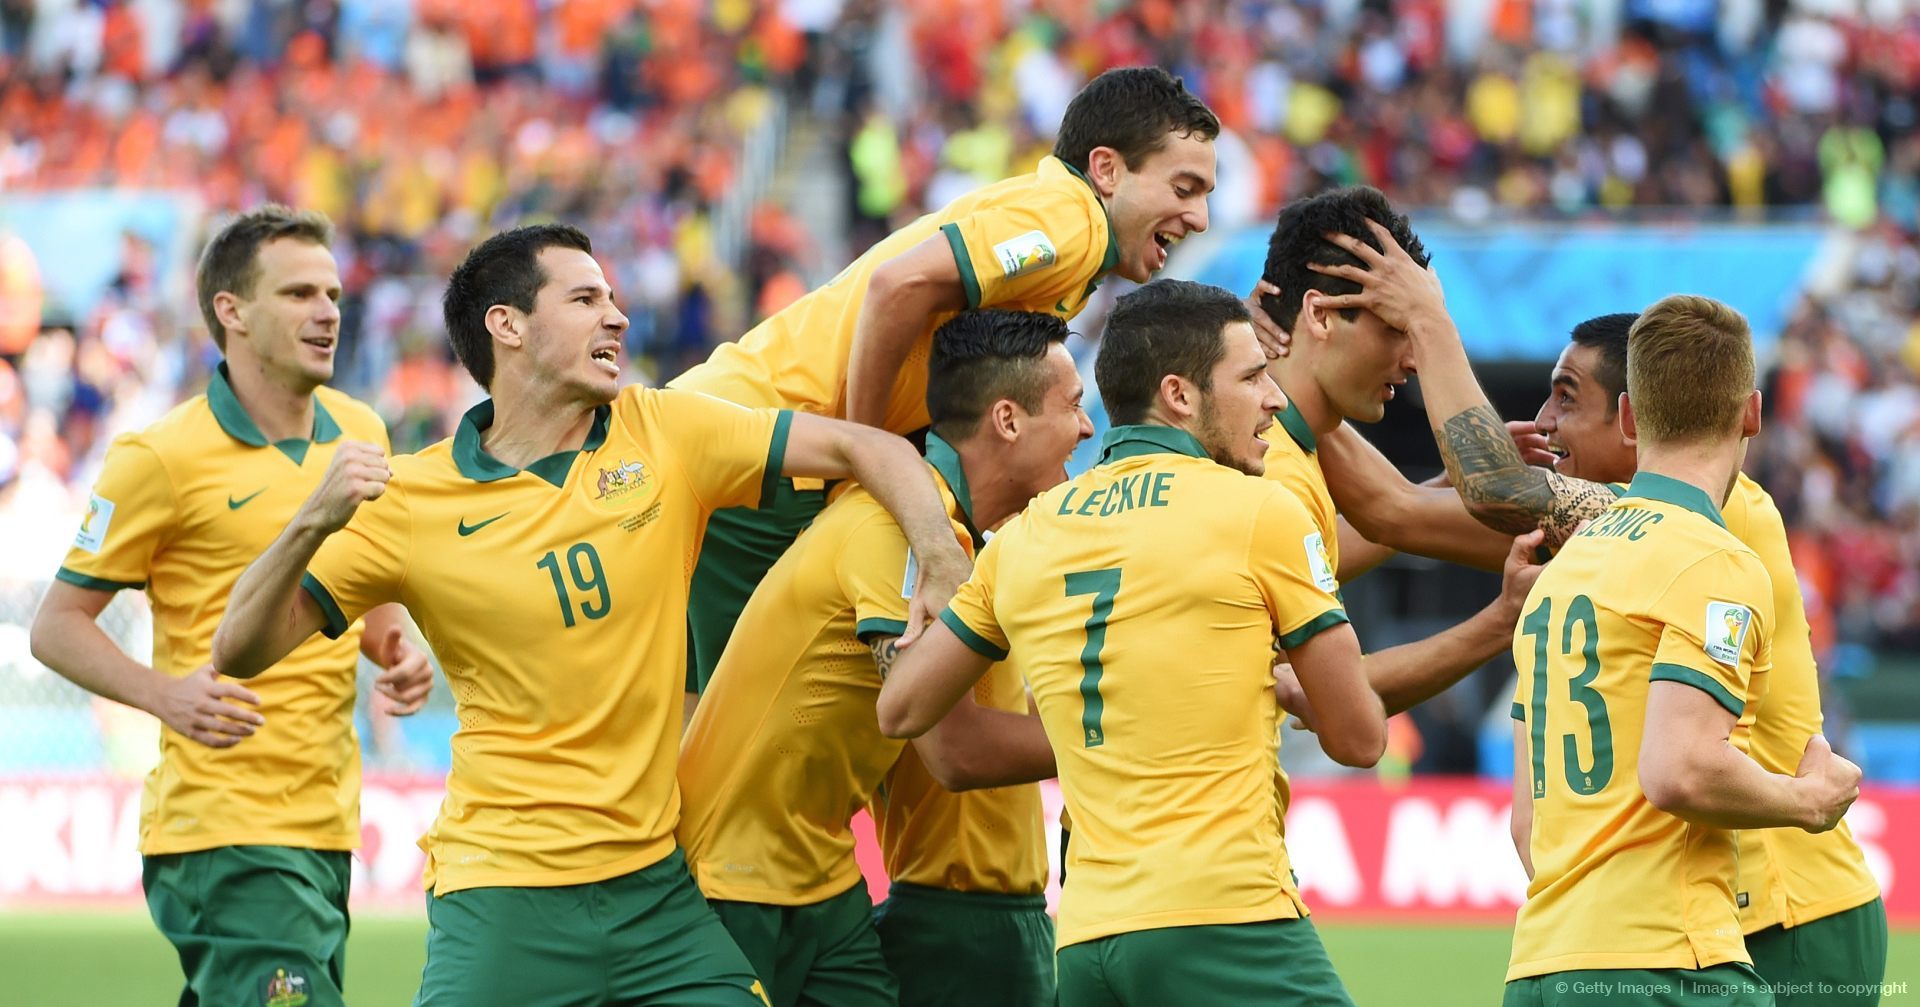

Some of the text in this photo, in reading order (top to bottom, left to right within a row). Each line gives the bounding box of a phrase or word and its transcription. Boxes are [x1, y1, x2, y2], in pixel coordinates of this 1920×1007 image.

[1057, 471, 1175, 517] LECKIE
[536, 541, 611, 628] 19
[1063, 567, 1122, 748] 7
[1522, 593, 1614, 799] 13
